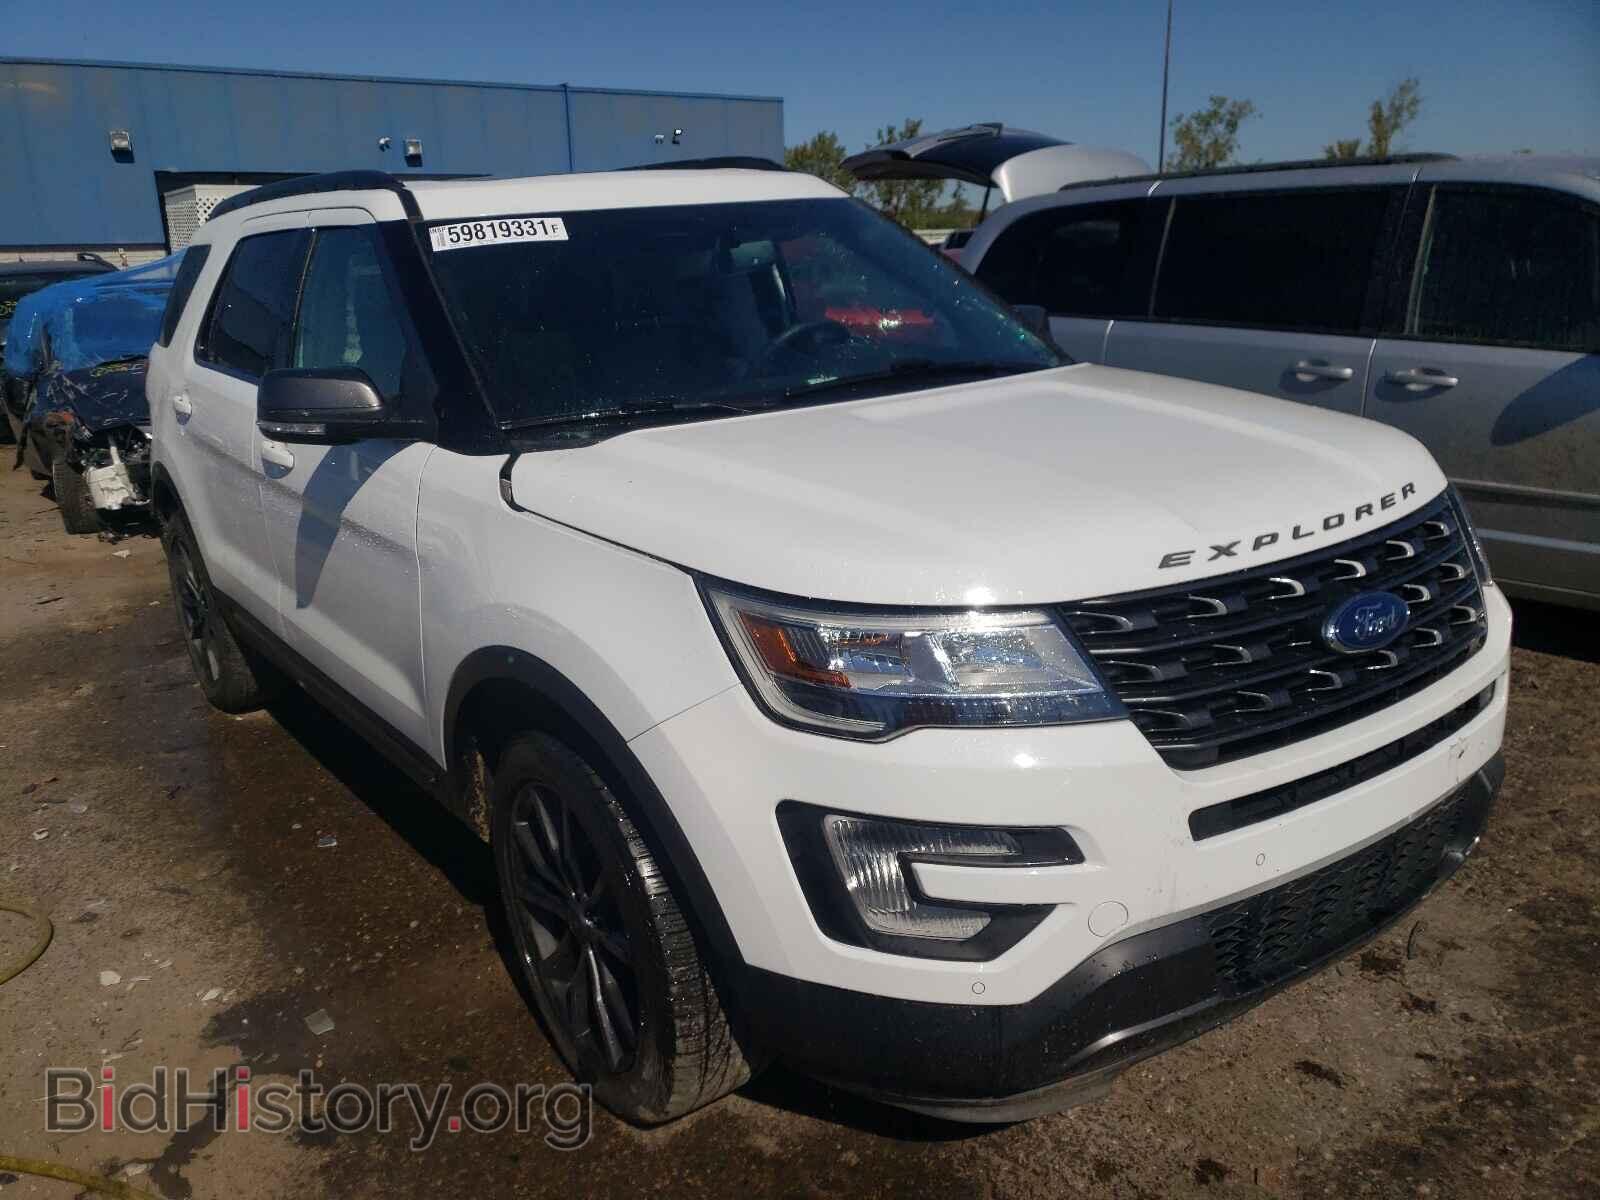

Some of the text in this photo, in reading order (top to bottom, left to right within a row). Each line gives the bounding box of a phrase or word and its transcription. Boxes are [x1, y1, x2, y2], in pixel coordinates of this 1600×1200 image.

[448, 220, 548, 243] 59819331
[1158, 482, 1417, 569] EXPLORER
[1353, 602, 1396, 640] Ford
